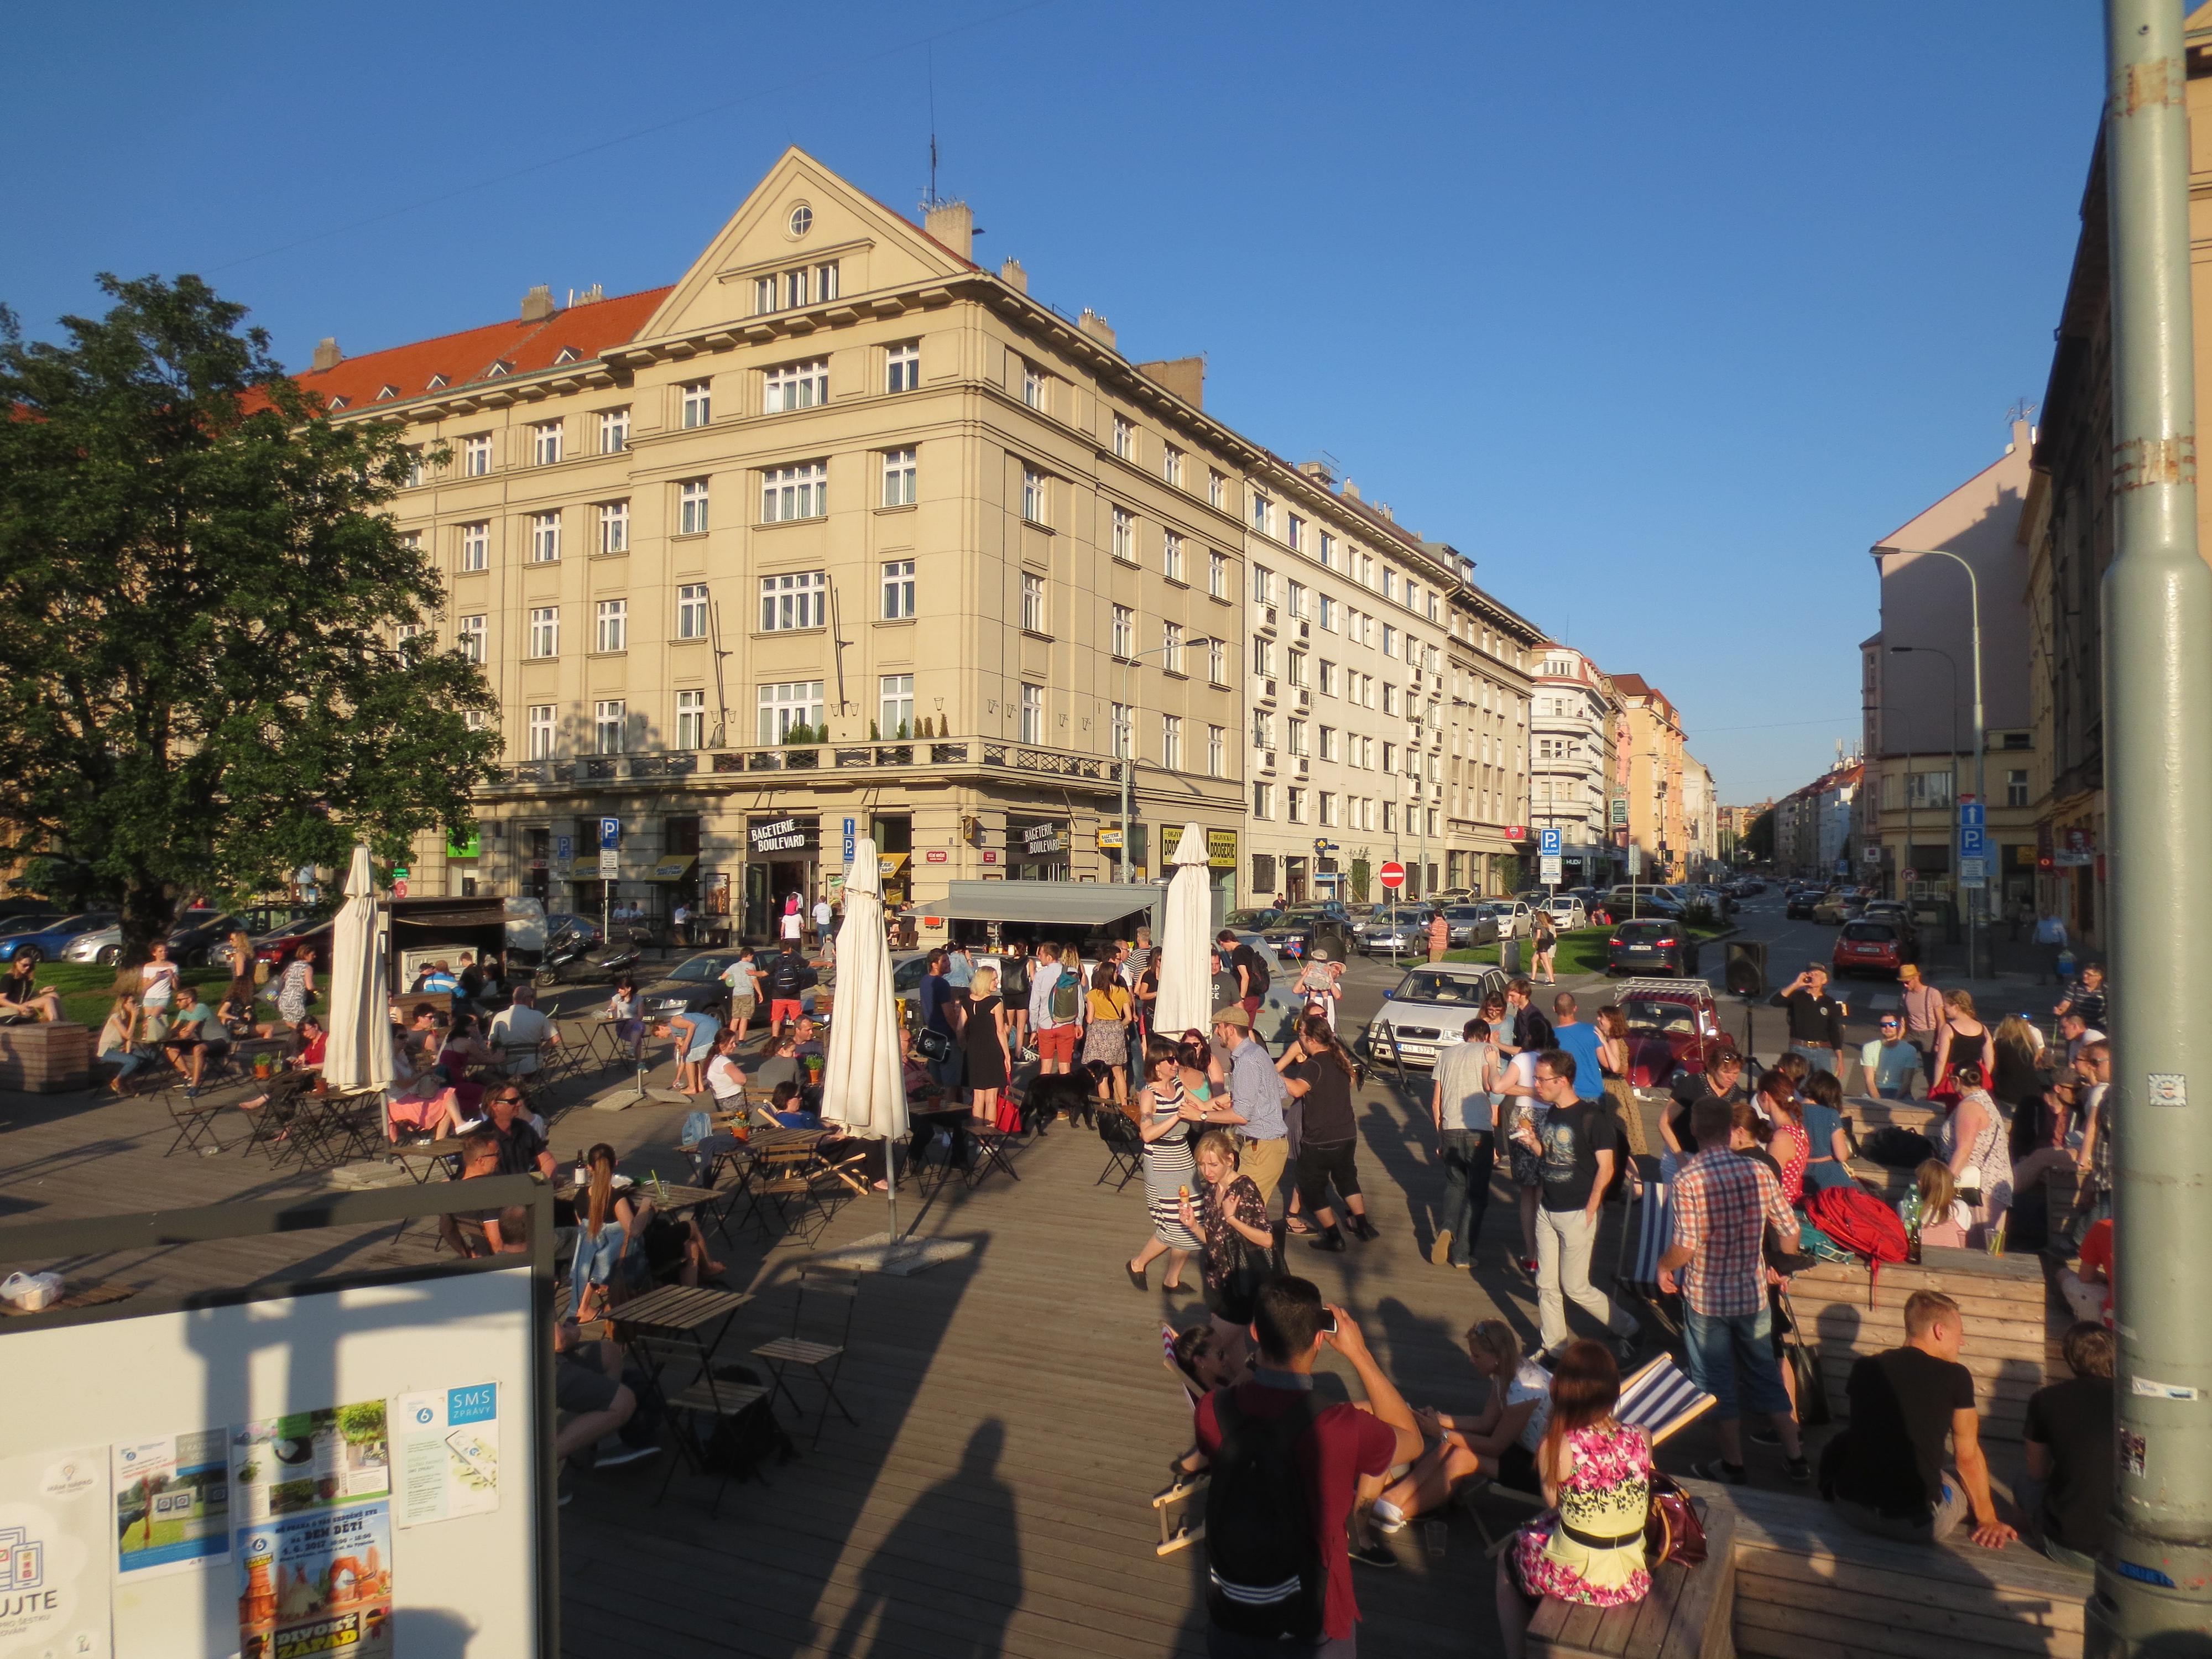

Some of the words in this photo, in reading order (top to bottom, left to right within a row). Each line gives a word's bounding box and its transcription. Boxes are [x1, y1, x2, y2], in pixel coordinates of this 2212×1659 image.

[605, 822, 615, 838] P
[752, 819, 795, 842] BAGETERIE
[1024, 823, 1053, 843] BAGETERIE
[758, 834, 805, 852] BOULEVARD
[846, 840, 852, 854] P
[1029, 839, 1060, 854] BOULEVARD
[1545, 832, 1557, 848] P
[1965, 831, 1979, 848] P
[1211, 842, 1235, 858] DROGERIE
[453, 1390, 491, 1408] SMS
[305, 1527, 330, 1541] DEN
[333, 1517, 363, 1535] DĚTÍ
[305, 1540, 327, 1550] 2017
[276, 1613, 358, 1646] DIVOKÝ
